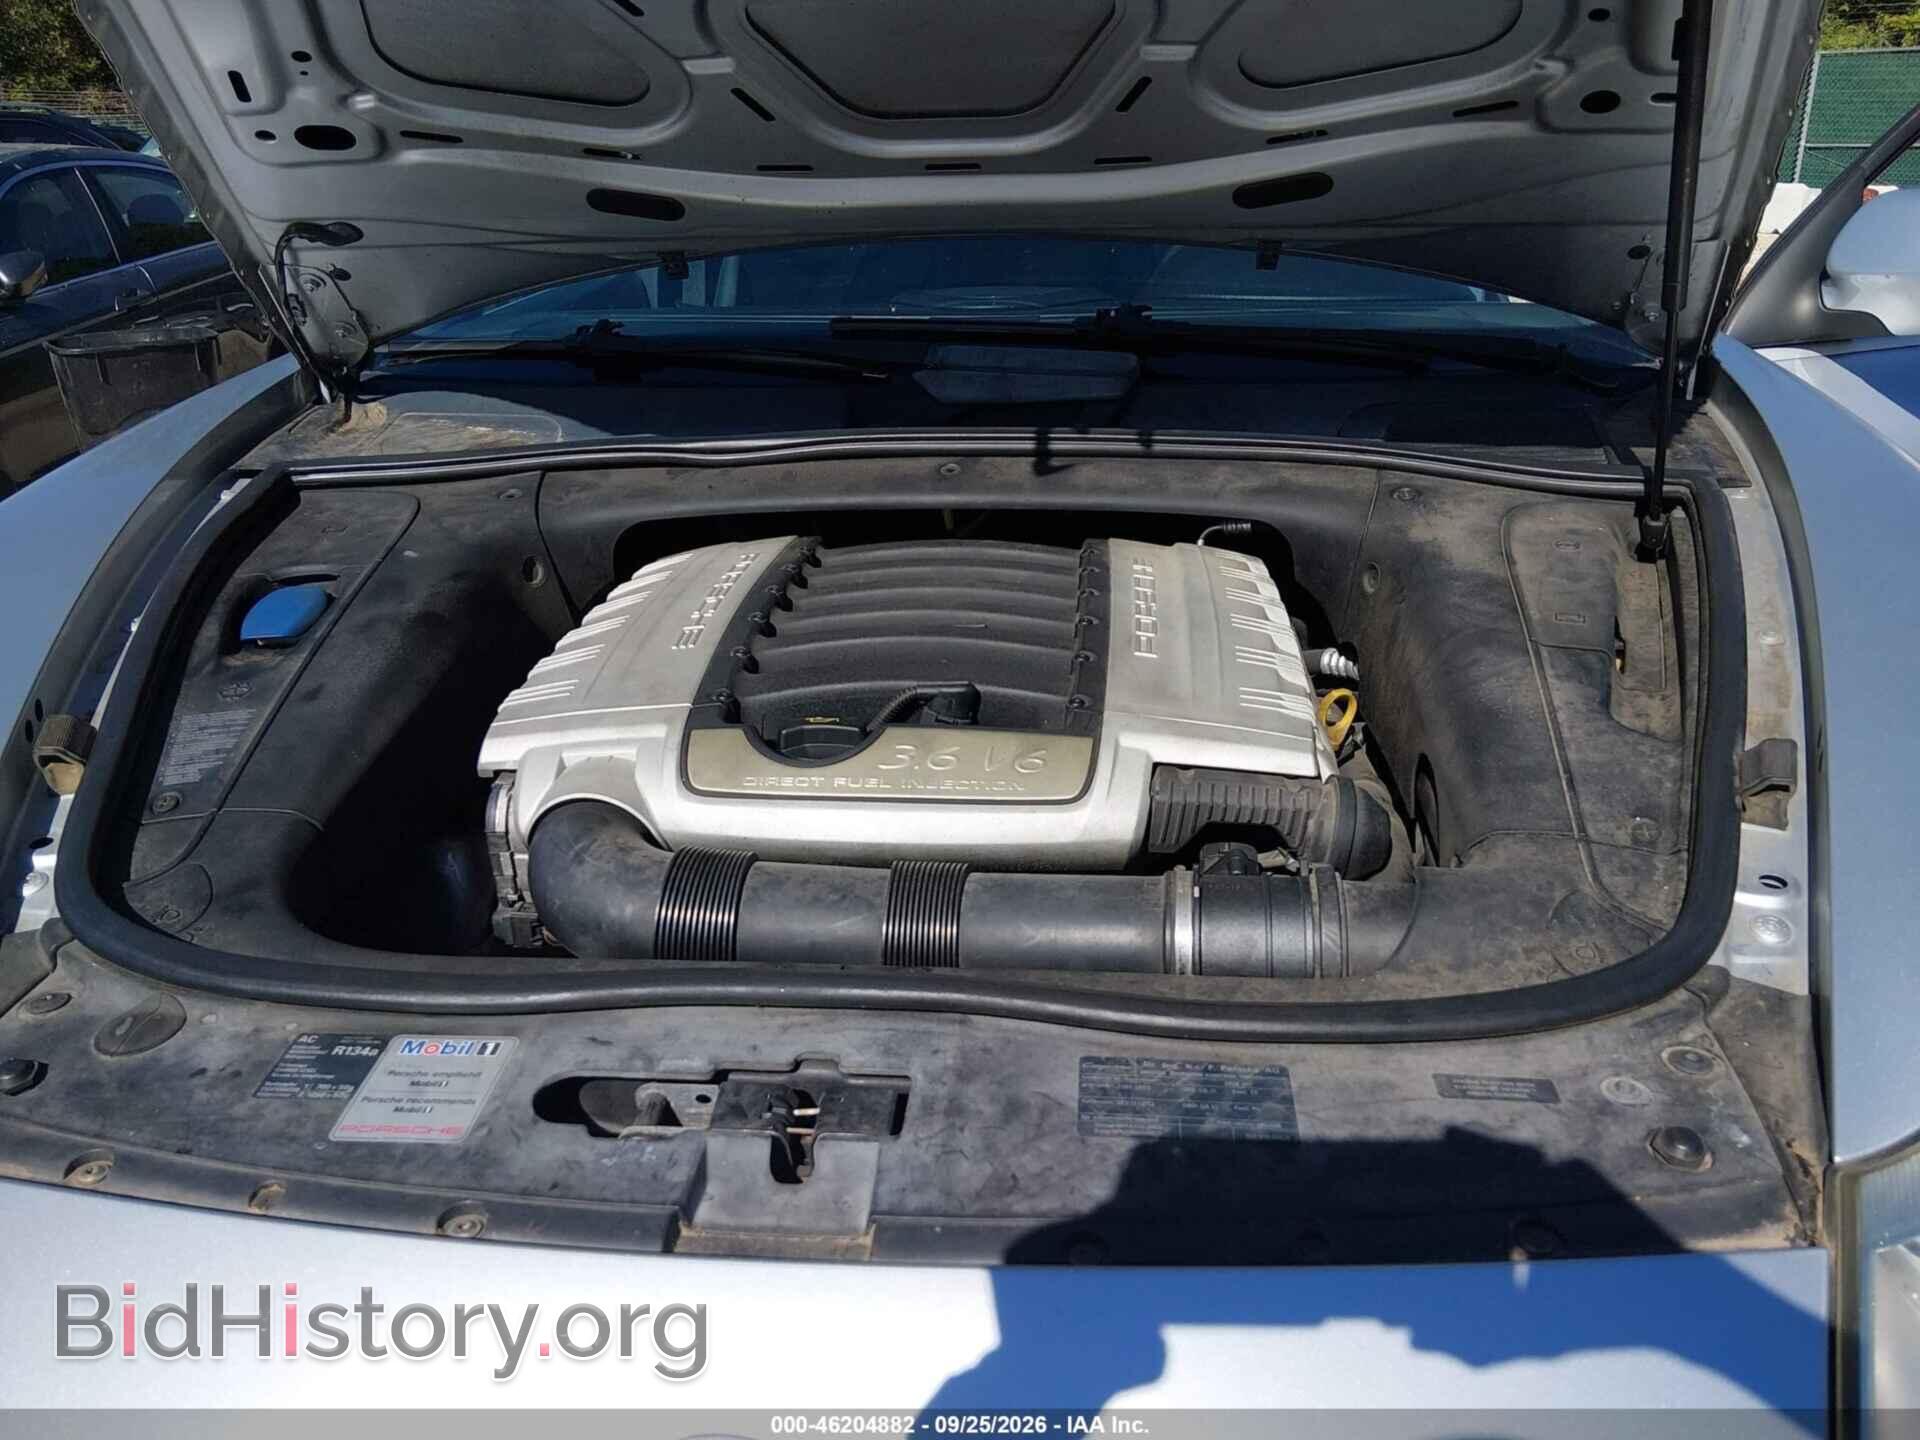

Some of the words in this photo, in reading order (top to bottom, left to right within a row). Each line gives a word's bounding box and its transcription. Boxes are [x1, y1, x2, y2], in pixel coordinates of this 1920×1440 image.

[672, 553, 758, 650] PORSCHE
[1131, 558, 1158, 659] PORSCHE
[877, 744, 961, 771] 3.6
[984, 745, 1048, 774] V6
[743, 776, 825, 788] DIRECT
[833, 777, 892, 789] FUEL
[901, 777, 1026, 791] INJECTION
[299, 1035, 319, 1044] AC
[331, 1045, 379, 1056] R134a
[400, 1040, 475, 1056] Mobil
[387, 1069, 430, 1078] Porsche
[409, 1080, 439, 1088] Mobil
[361, 1096, 404, 1104] Porsche
[393, 1106, 423, 1114] Mobil
[339, 1124, 465, 1136] PORSCHE
